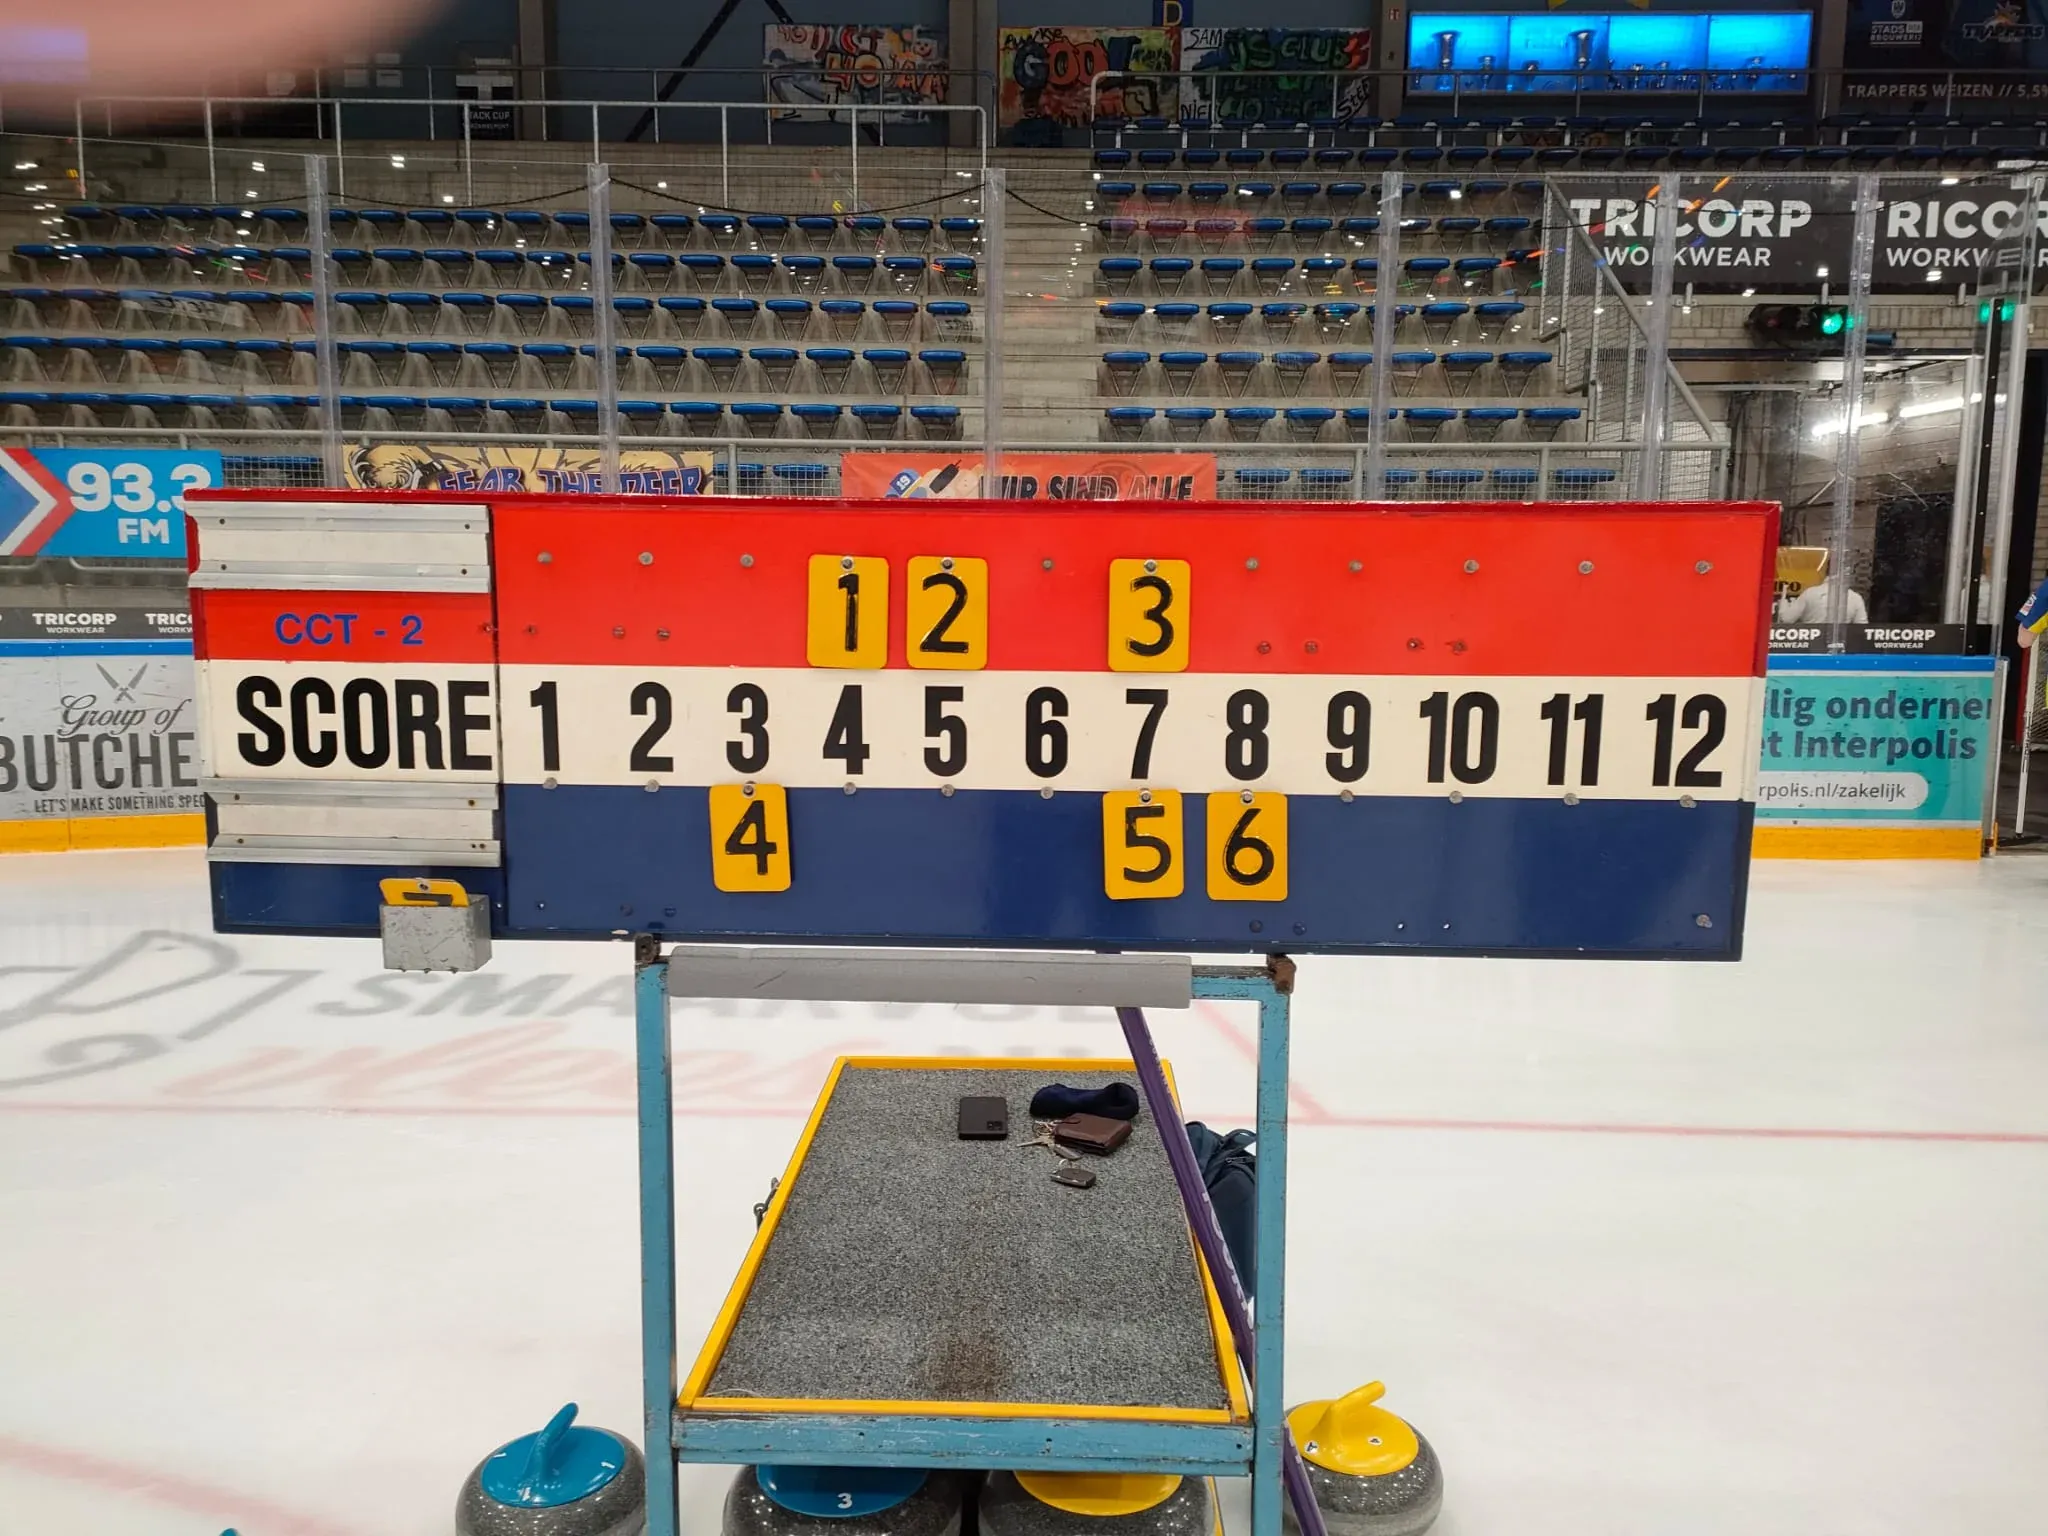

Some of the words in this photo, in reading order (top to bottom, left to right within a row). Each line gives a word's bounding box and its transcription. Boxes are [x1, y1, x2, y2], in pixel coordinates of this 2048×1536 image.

[1163, 0, 1183, 27] D
[1848, 85, 1929, 97] TRAPPERS
[1932, 84, 1994, 97] WEIZEN
[463, 111, 490, 120] TACK
[1570, 199, 1812, 237] TRICORP
[1603, 246, 1771, 266] WOKWEAR
[67, 462, 211, 512] 93.3
[438, 466, 524, 492] FEAR
[537, 468, 603, 493] THE
[620, 466, 703, 495] DEER
[1048, 475, 1119, 500] SIND
[1129, 475, 1195, 500] ALLE
[118, 518, 170, 544] FM
[32, 613, 117, 625] TRICORP
[838, 573, 859, 652] 1
[920, 573, 969, 653] 2
[1127, 575, 1174, 657] 3
[275, 613, 358, 645] CCT
[401, 615, 423, 645] 2
[1864, 629, 1936, 641] TRICORP
[57, 694, 146, 737] Group
[153, 698, 192, 735] of
[236, 675, 493, 770] SCORE
[530, 681, 560, 771] 1
[630, 681, 674, 772] 2
[726, 683, 769, 774] 3
[823, 685, 870, 775] 4
[924, 686, 967, 777] 5
[1025, 687, 1069, 778] 6
[1126, 689, 1169, 780] 7
[1225, 689, 1269, 781] 8
[1325, 691, 1371, 783] 9
[1419, 691, 1500, 784] 10
[1541, 693, 1604, 786] 11
[1646, 693, 1727, 787] 12
[1760, 731, 1783, 758] t
[1794, 728, 1977, 766] Interpolis
[35, 798, 67, 813] LET'S
[71, 797, 104, 812] MAKE
[108, 795, 175, 810] SOMETHING
[1759, 783, 1906, 802] rpolis.nl/zakelijk
[725, 800, 777, 875] 4
[1124, 804, 1172, 883] 5
[1223, 808, 1275, 886] 6
[837, 1492, 853, 1509] 3
